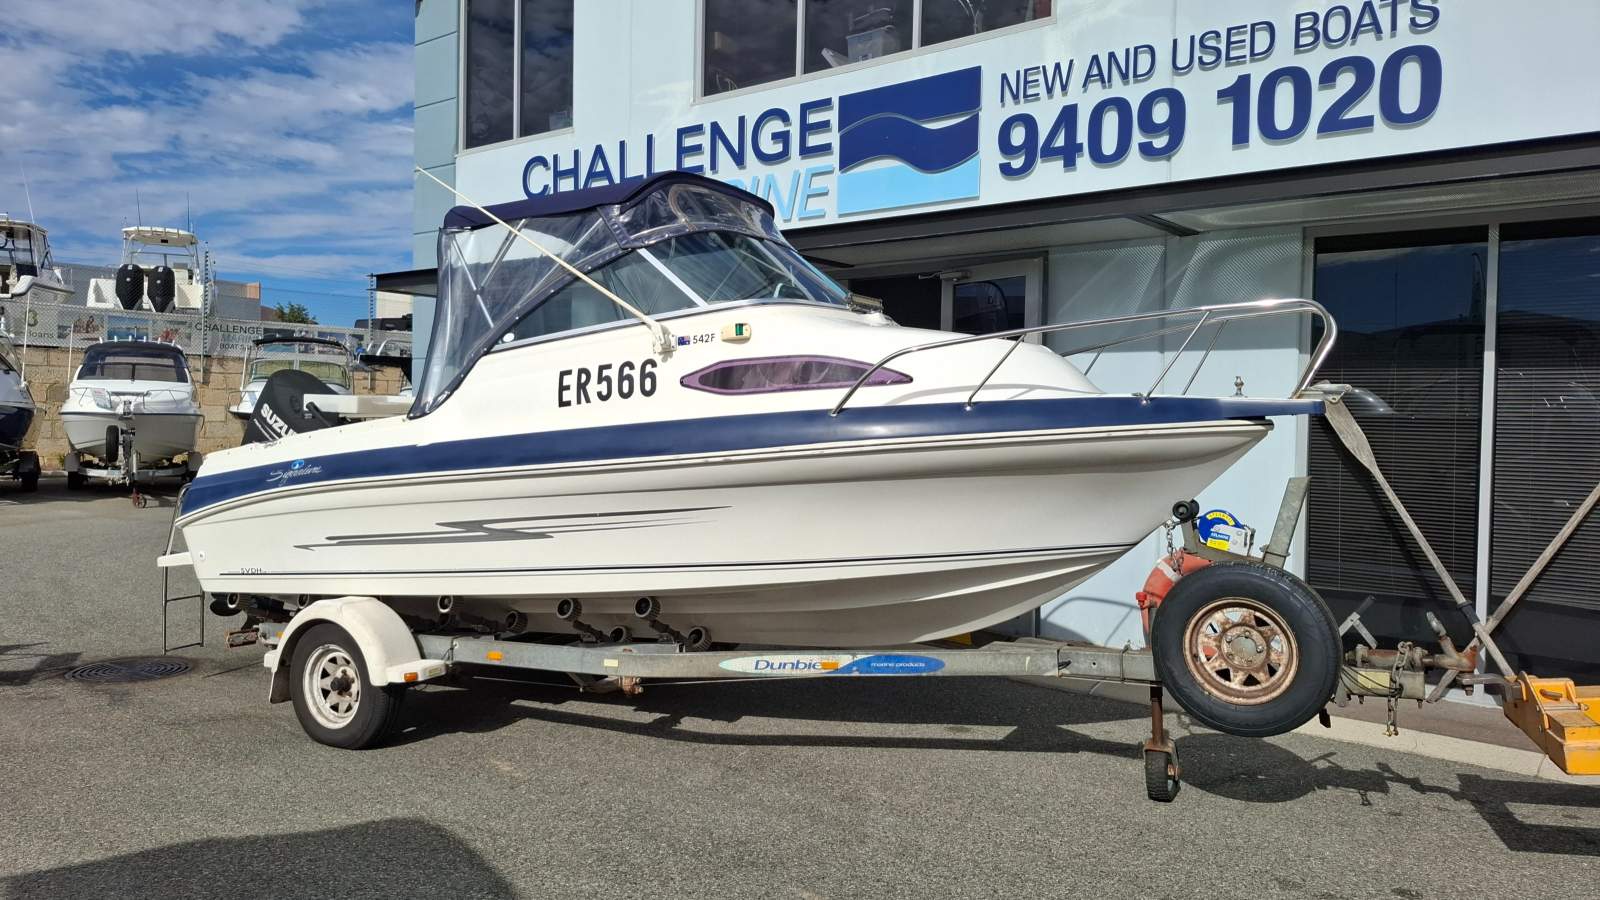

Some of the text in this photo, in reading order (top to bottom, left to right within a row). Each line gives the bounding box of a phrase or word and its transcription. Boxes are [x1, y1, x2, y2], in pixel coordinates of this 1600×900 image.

[1000, 0, 1441, 103] NEW AND USED BOATS
[522, 97, 834, 200] CHALLENGE
[998, 44, 1443, 178] 9409 1020
[692, 333, 716, 345] 542F
[558, 358, 658, 408] ER566
[754, 659, 822, 671] Dunbie
